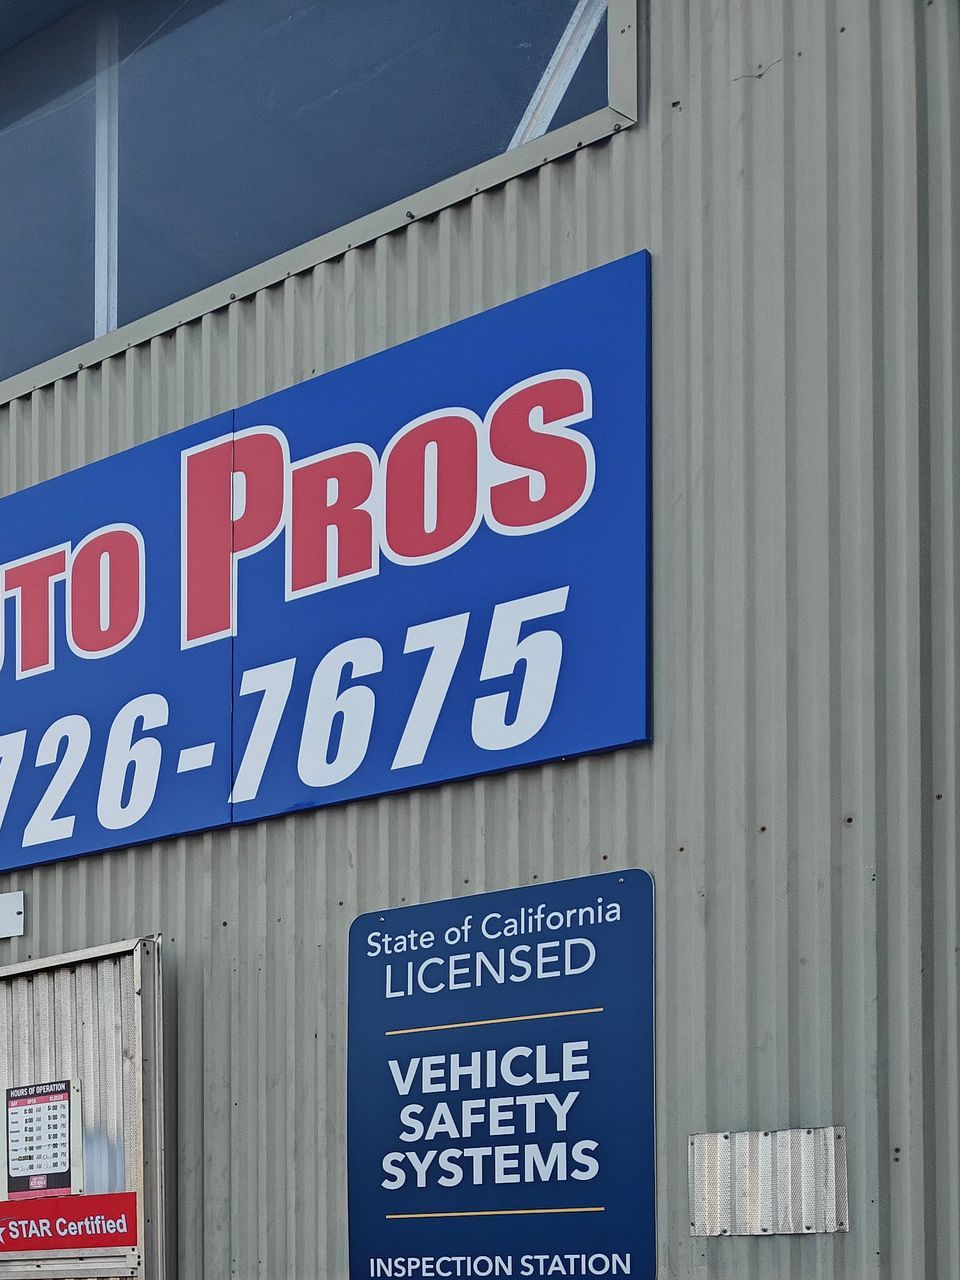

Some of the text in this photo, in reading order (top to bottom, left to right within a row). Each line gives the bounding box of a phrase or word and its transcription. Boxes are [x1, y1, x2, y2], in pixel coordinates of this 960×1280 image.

[366, 897, 622, 957] State of California
[385, 937, 597, 999] LICENSED
[10, 1088, 28, 1098] HOURS
[36, 1082, 66, 1094] OPERATION
[387, 1040, 590, 1096] VEHICLE
[399, 1091, 581, 1143] SAFETY
[381, 1139, 600, 1190] SYSTEMS
[8, 1213, 128, 1240] STAR Certified
[369, 1253, 631, 1278] INSPECTION STATION
